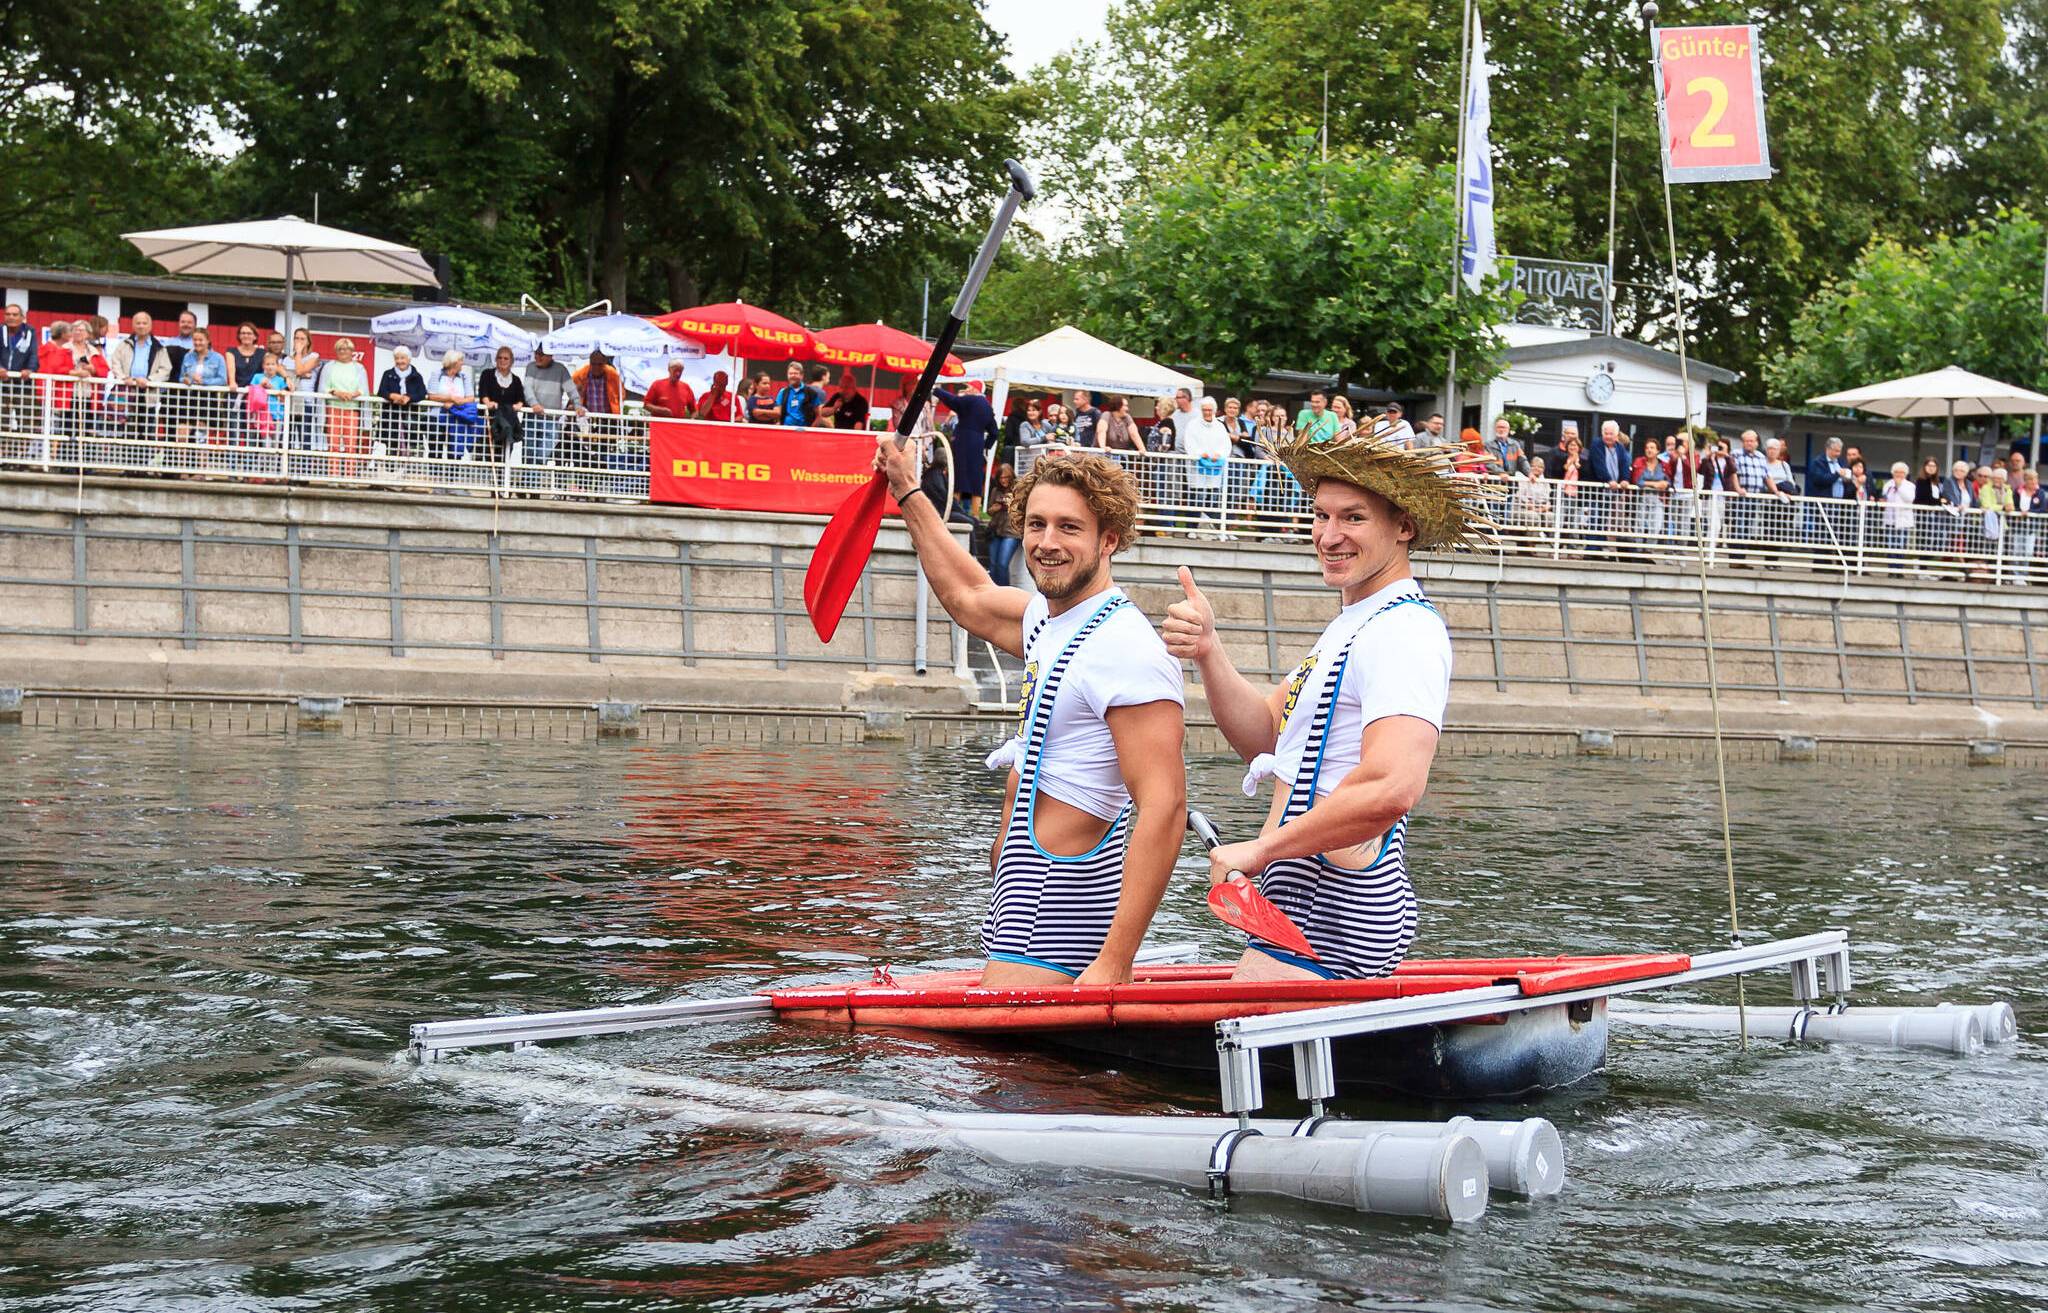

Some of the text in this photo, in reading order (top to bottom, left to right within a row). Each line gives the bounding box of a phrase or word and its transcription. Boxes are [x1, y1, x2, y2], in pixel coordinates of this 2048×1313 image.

[1662, 35, 1749, 61] Günter
[1686, 76, 1736, 148] 2
[682, 320, 742, 335] DLRG
[750, 325, 805, 344] DLRG
[886, 355, 929, 370] DLR
[672, 459, 771, 481] DLRG
